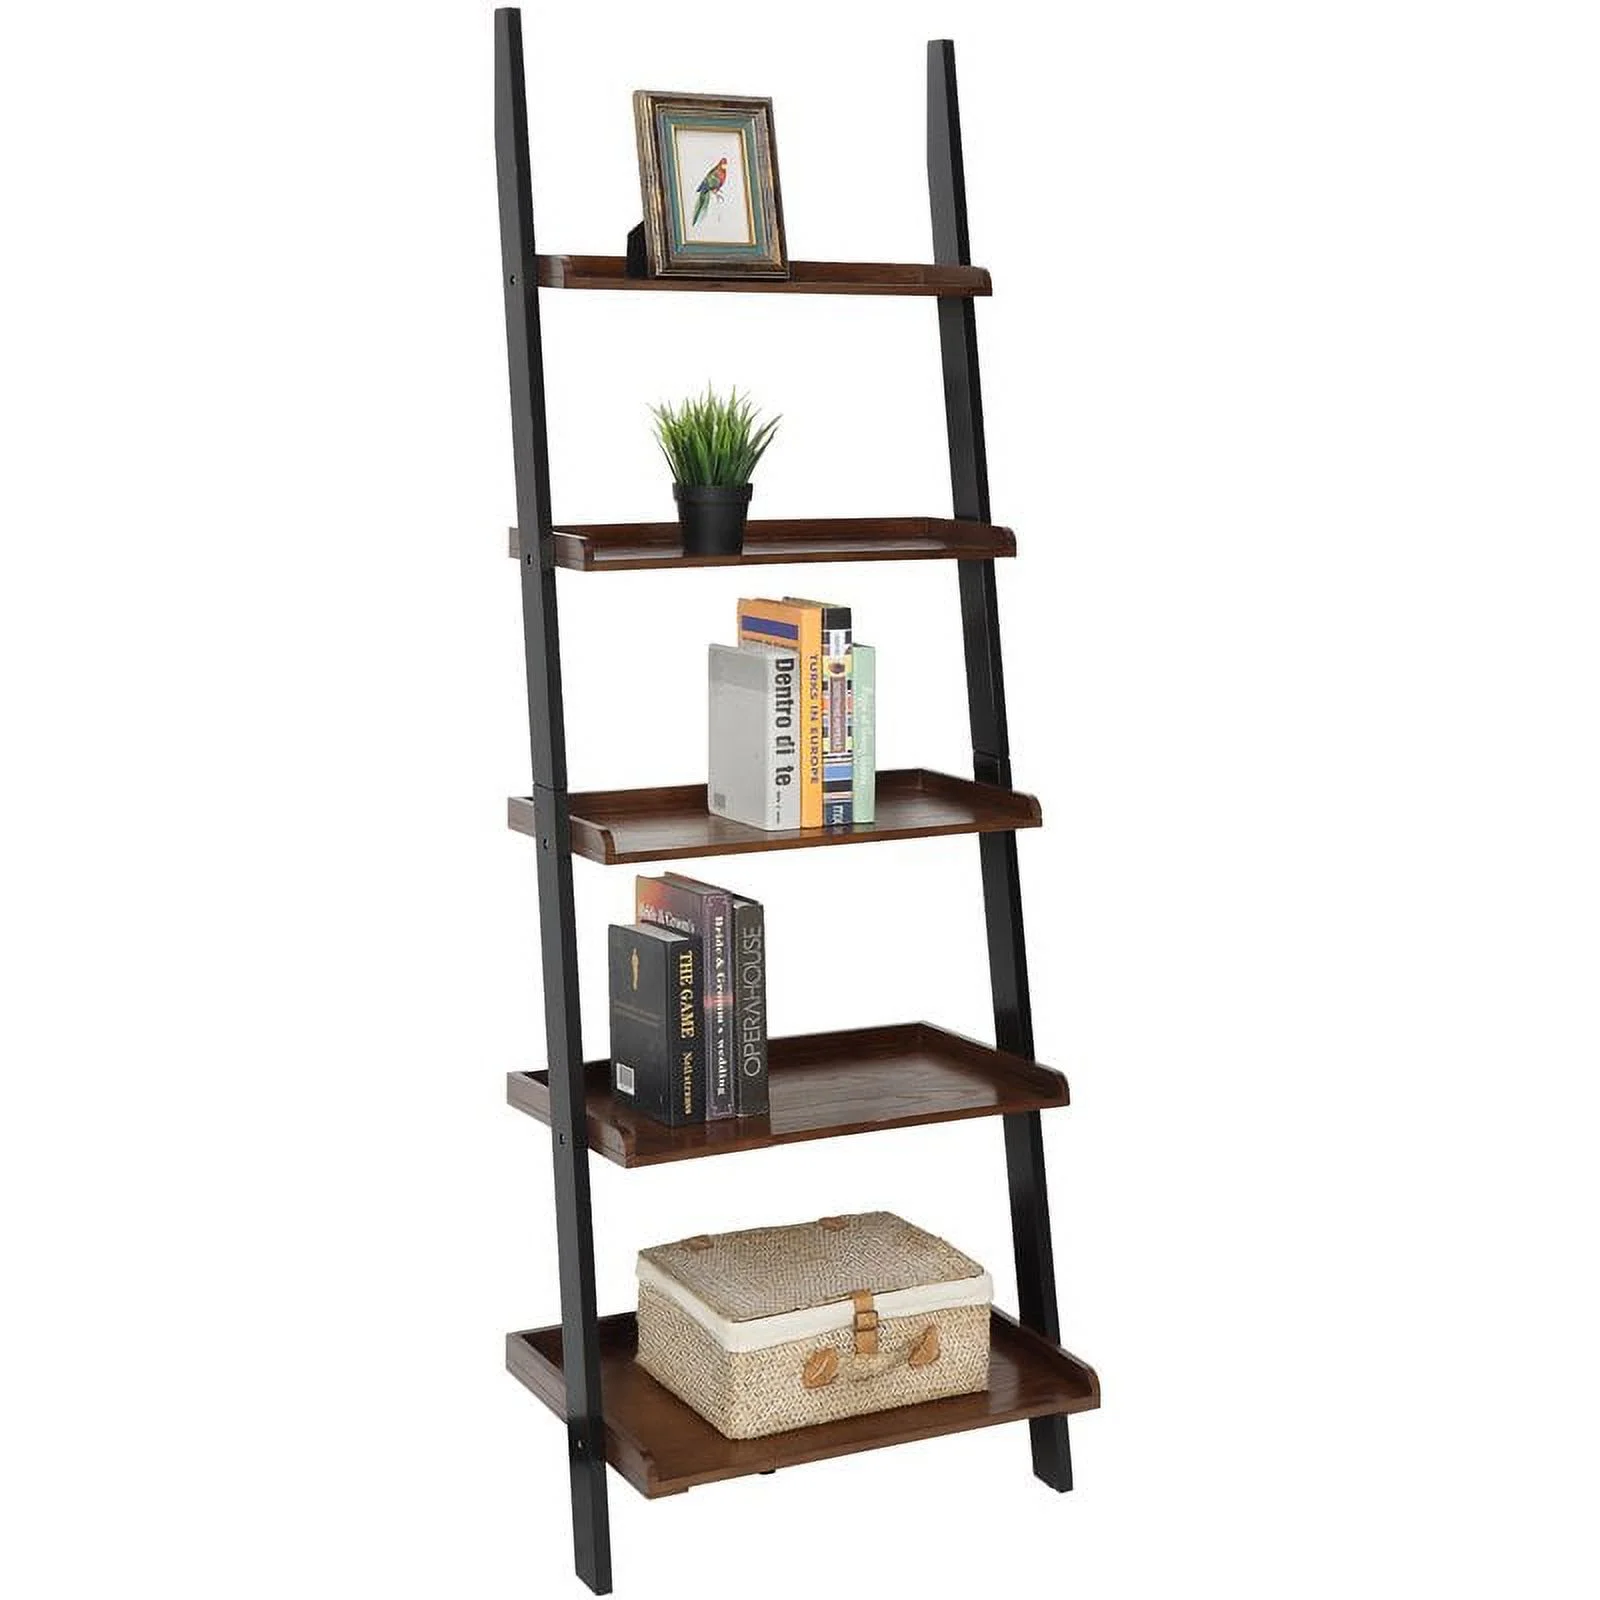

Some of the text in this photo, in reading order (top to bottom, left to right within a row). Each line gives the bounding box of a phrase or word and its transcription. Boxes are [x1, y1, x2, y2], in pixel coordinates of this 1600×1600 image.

[774, 658, 795, 786] Dentro di te
[809, 655, 819, 785] TURKS IN EUROPE
[714, 916, 725, 954] Bride
[679, 950, 694, 986] THE
[715, 957, 725, 969] &
[680, 988, 695, 1039] GAME
[717, 1039, 728, 1096] wedding
